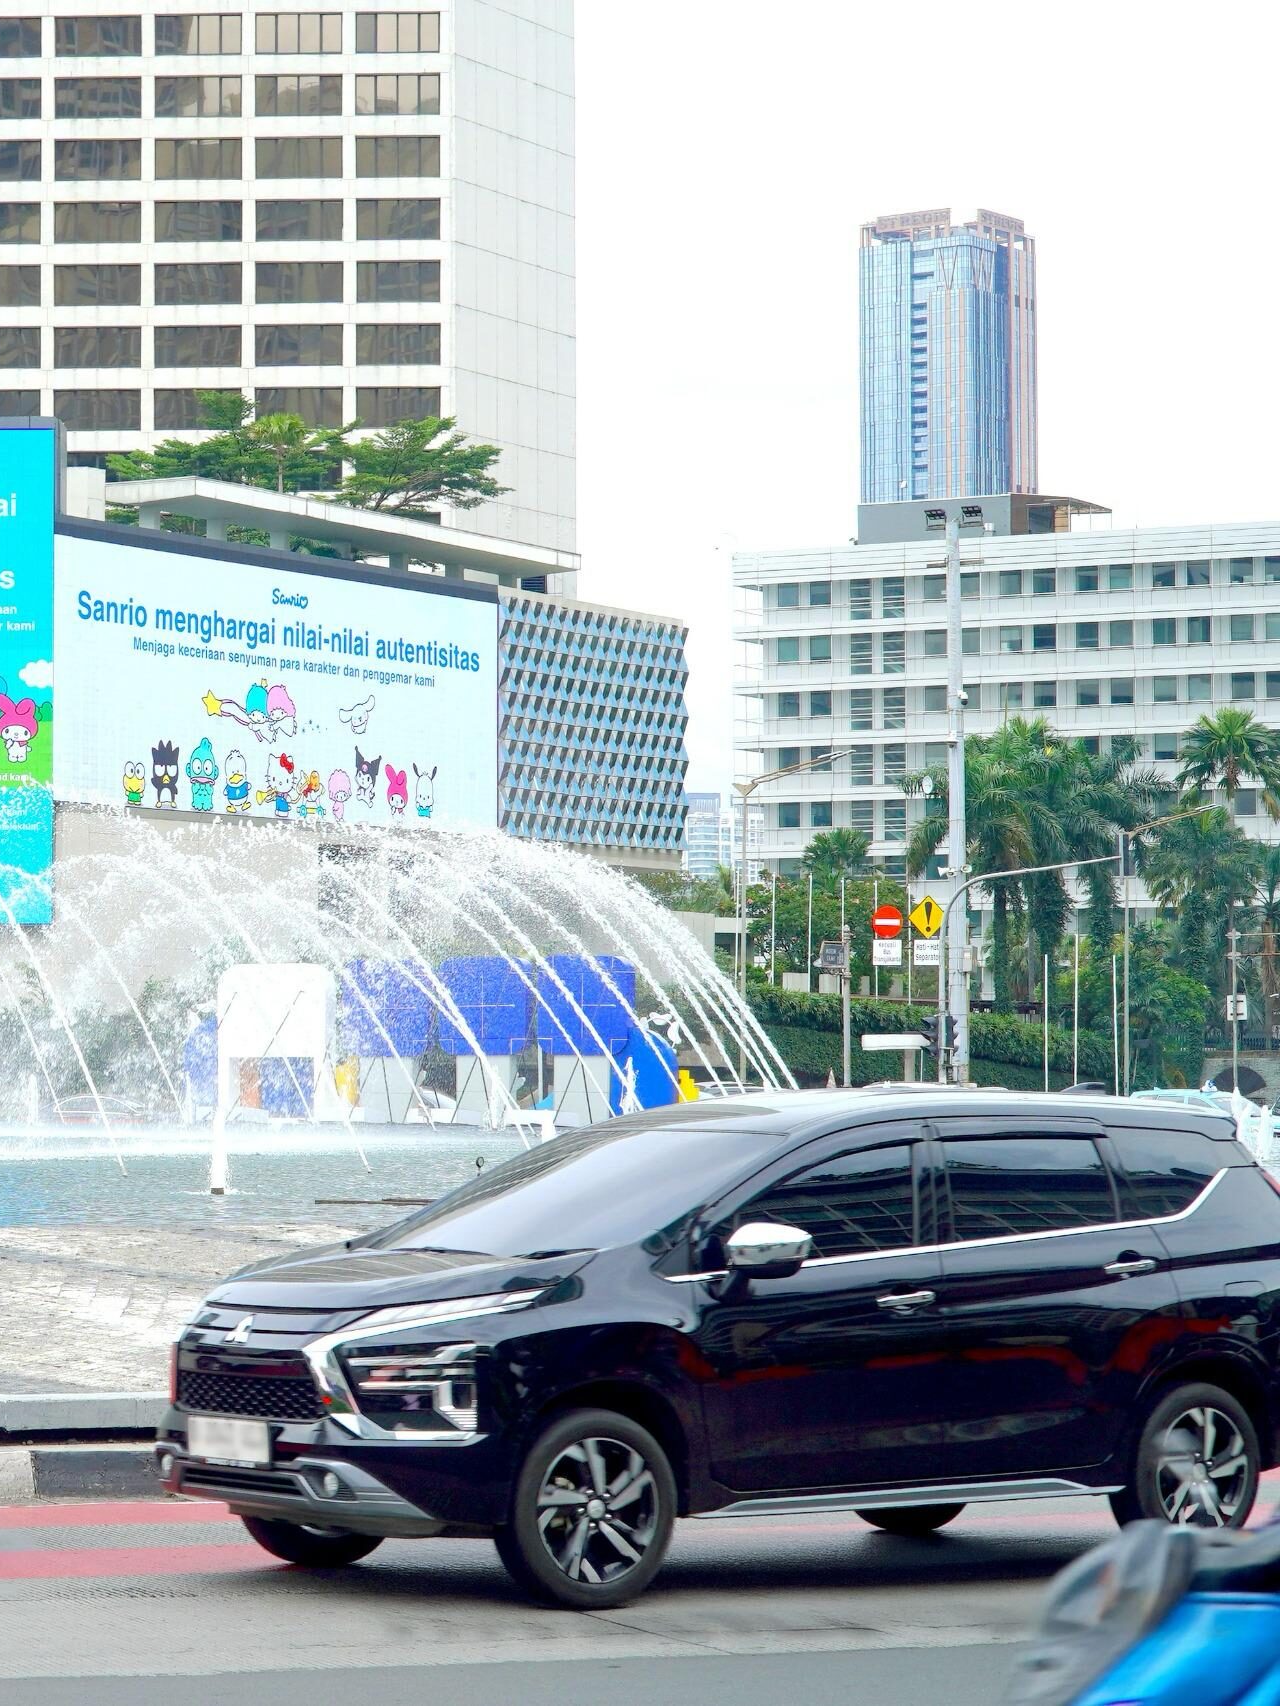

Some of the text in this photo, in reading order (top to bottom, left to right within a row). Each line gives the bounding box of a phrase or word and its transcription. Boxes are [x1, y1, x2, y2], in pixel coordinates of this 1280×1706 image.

[272, 588, 309, 610] Sanrio
[6, 621, 36, 631] kami
[78, 590, 481, 672] Sanrio menghargai nilai-nilai autentisitas
[133, 636, 435, 688] Menjaga keceriaan senyuman para karakter dan penggemar kami
[915, 943, 939, 951] Hati-Hat
